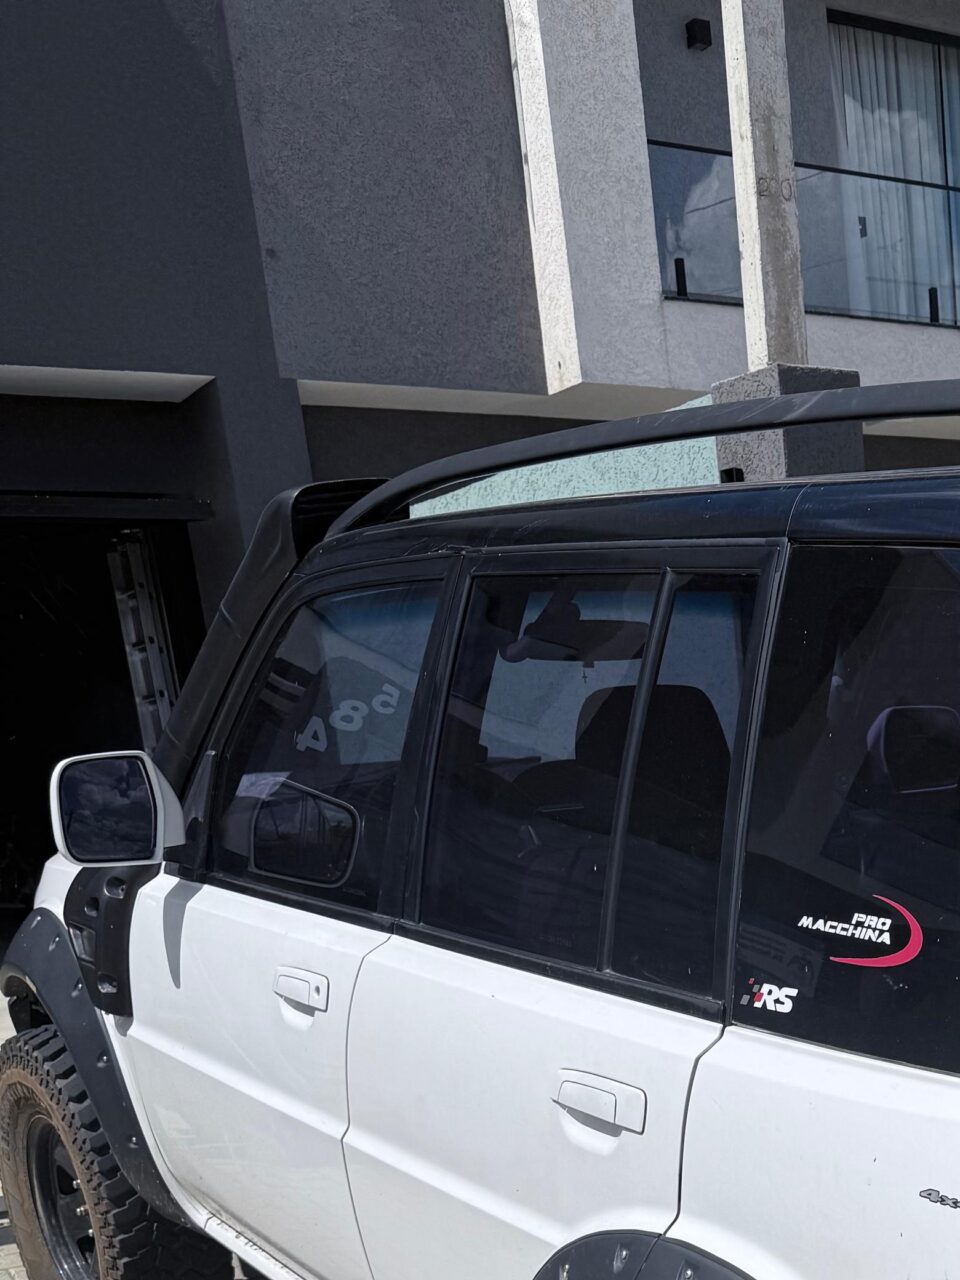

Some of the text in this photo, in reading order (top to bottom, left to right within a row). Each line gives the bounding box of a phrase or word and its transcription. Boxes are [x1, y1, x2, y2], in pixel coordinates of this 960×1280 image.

[797, 915, 891, 945] MACCHINA
[851, 912, 892, 931] PRO
[753, 983, 798, 1013] RS
